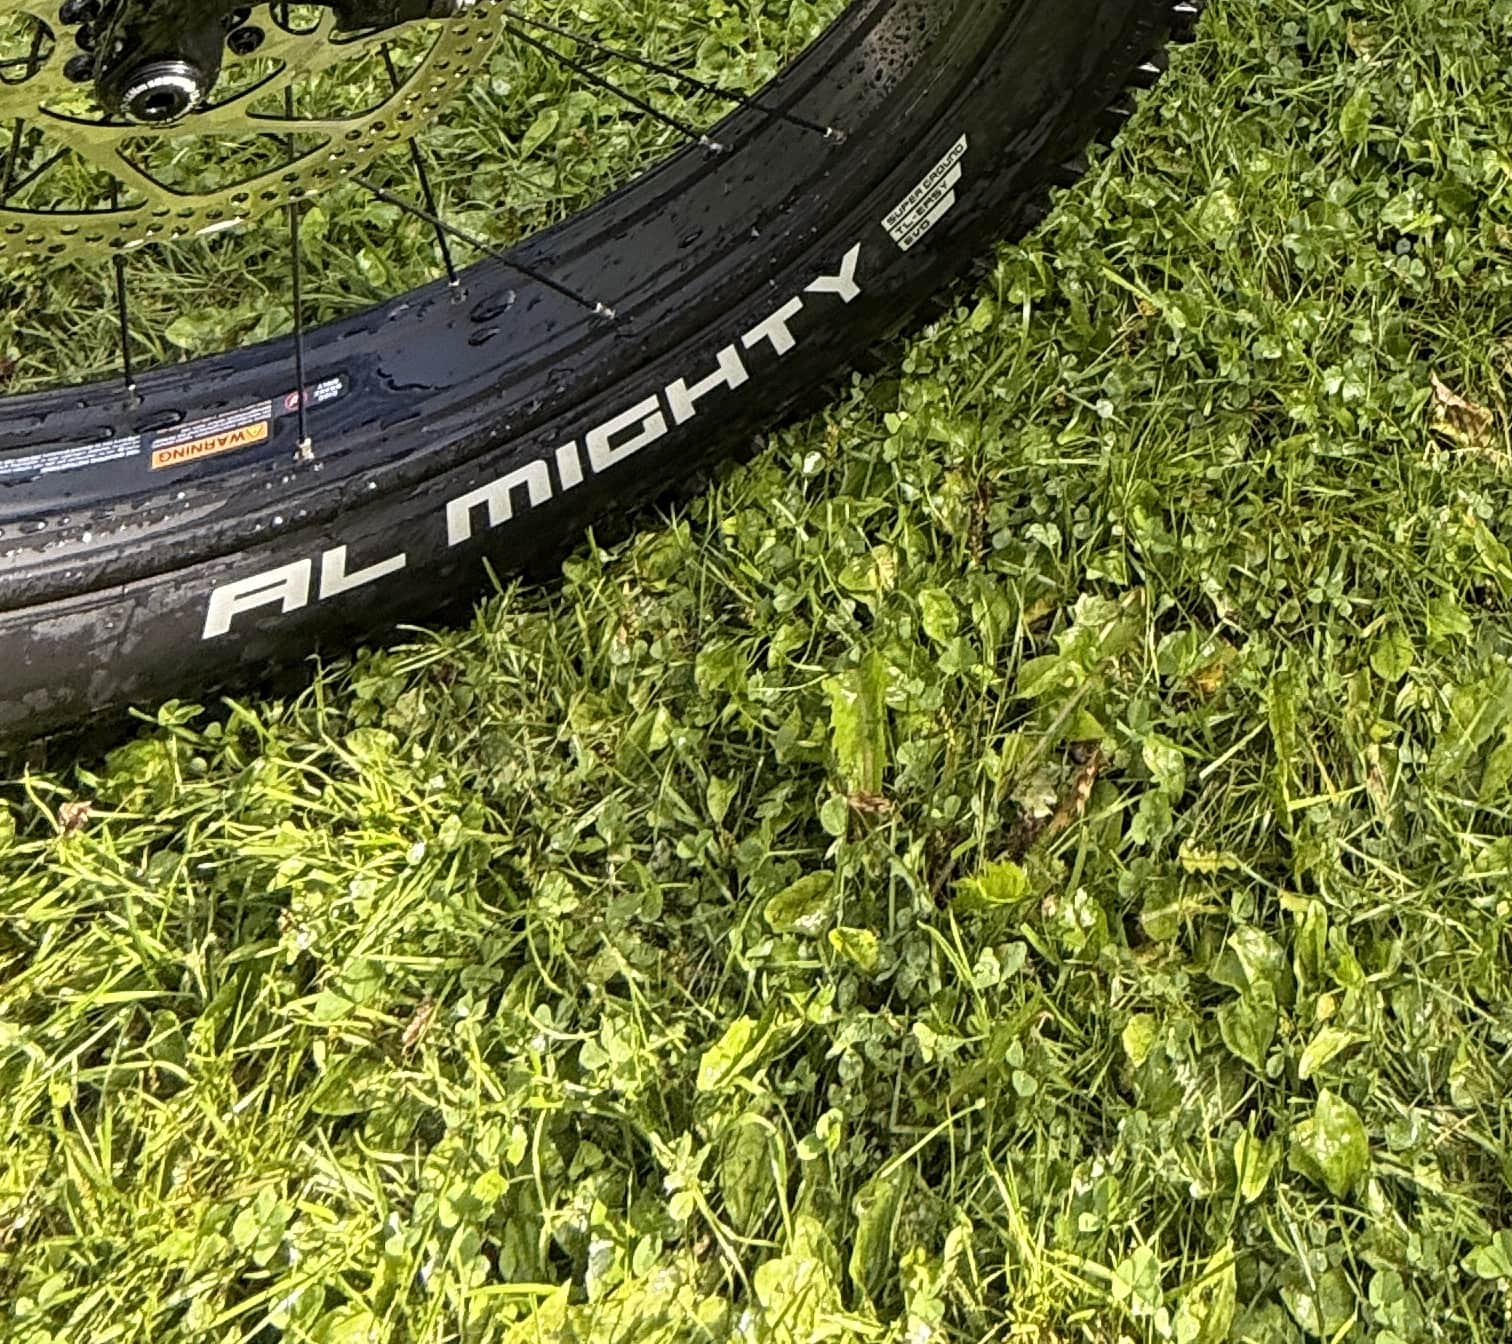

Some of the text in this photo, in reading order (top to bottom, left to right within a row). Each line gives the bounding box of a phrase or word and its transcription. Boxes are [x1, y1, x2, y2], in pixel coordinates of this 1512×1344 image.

[886, 187, 923, 226] SUPER
[158, 431, 246, 464] WARNING
[202, 241, 863, 640] AL MIGHTY
